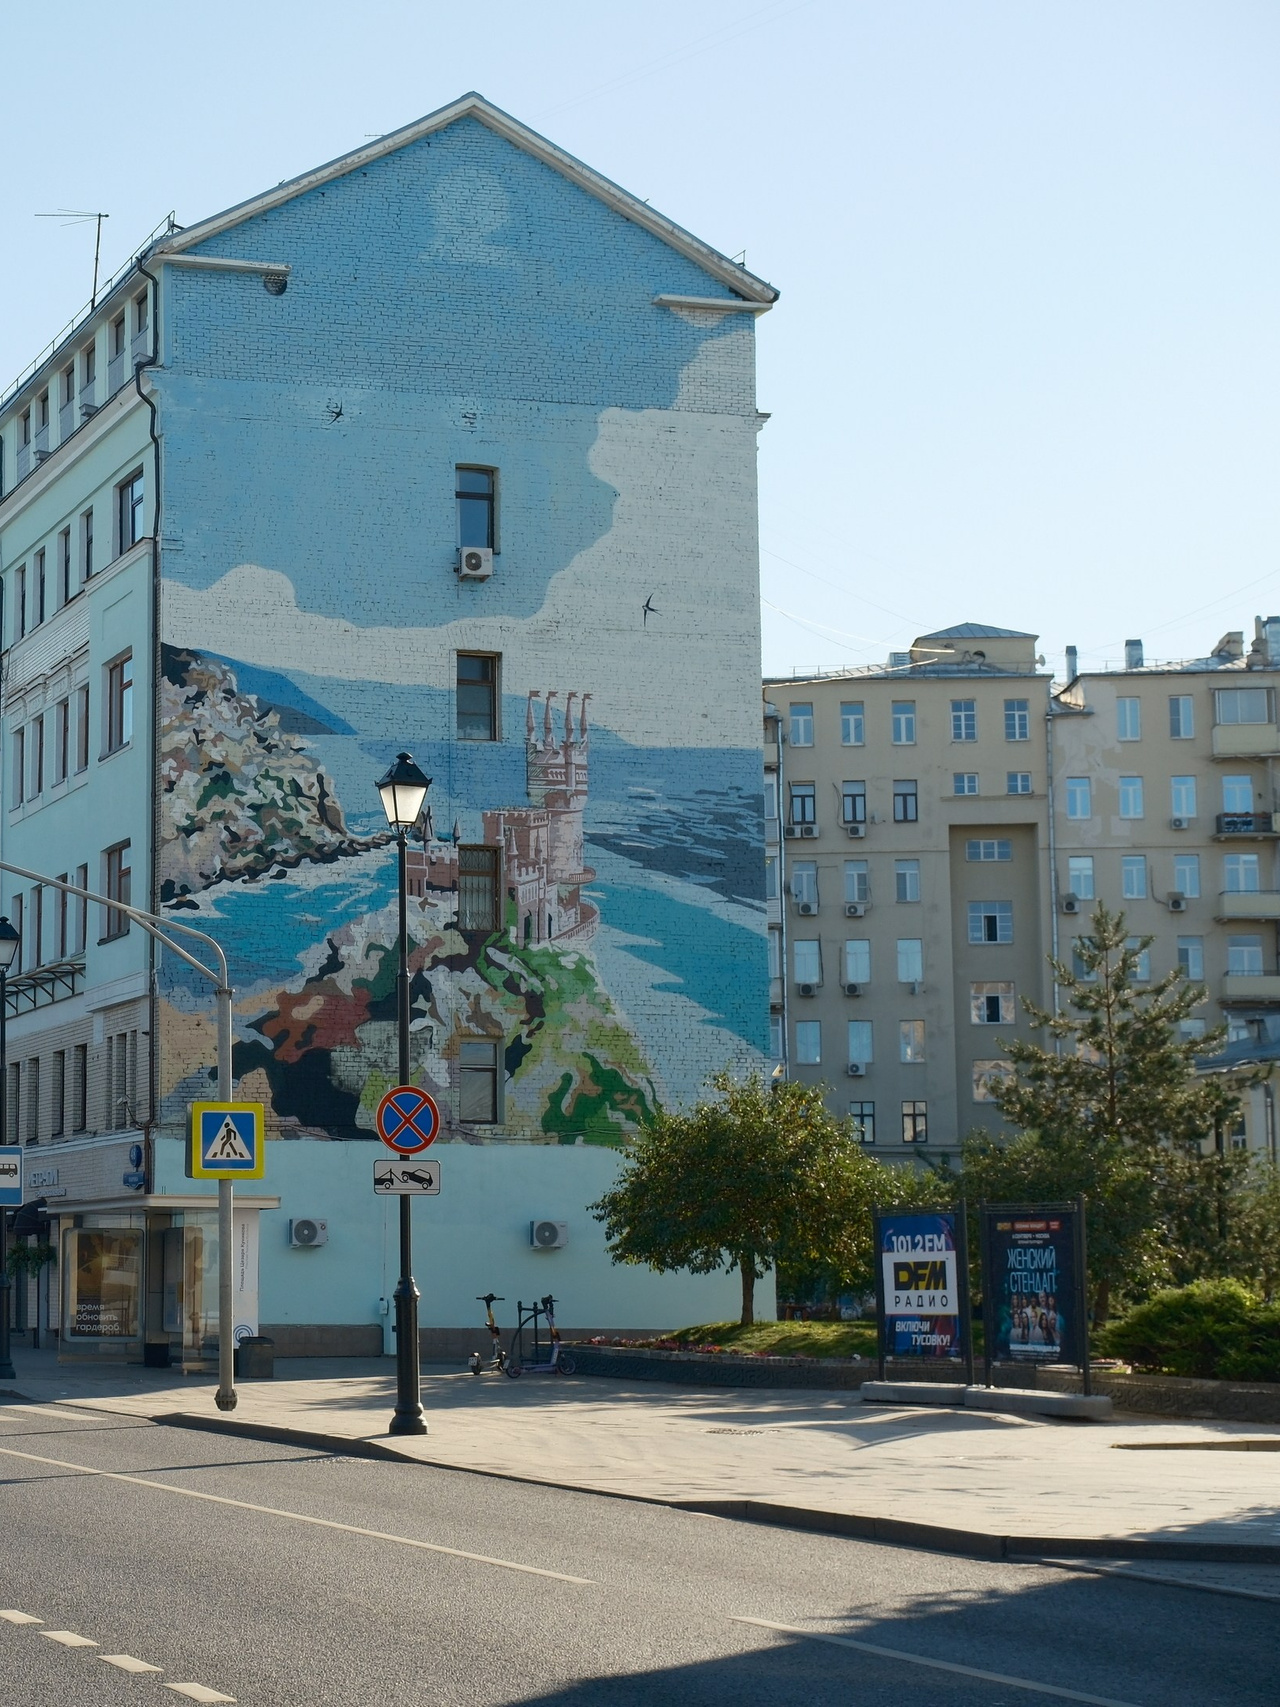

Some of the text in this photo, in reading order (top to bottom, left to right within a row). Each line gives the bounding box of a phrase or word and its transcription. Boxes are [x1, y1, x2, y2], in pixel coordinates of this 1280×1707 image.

[891, 1233, 946, 1252] 101.2 FM
[1007, 1246, 1055, 1269] ЖЕНСКИЙ
[893, 1261, 947, 1290] DFM
[1009, 1271, 1055, 1293] СТЕНДАП
[894, 1295, 949, 1308] РАДИО
[76, 1304, 105, 1313] время
[76, 1311, 119, 1321] обновить
[895, 1321, 930, 1333] ВКЛЮЧИ
[911, 1334, 951, 1346] ТУСОВКУ!
